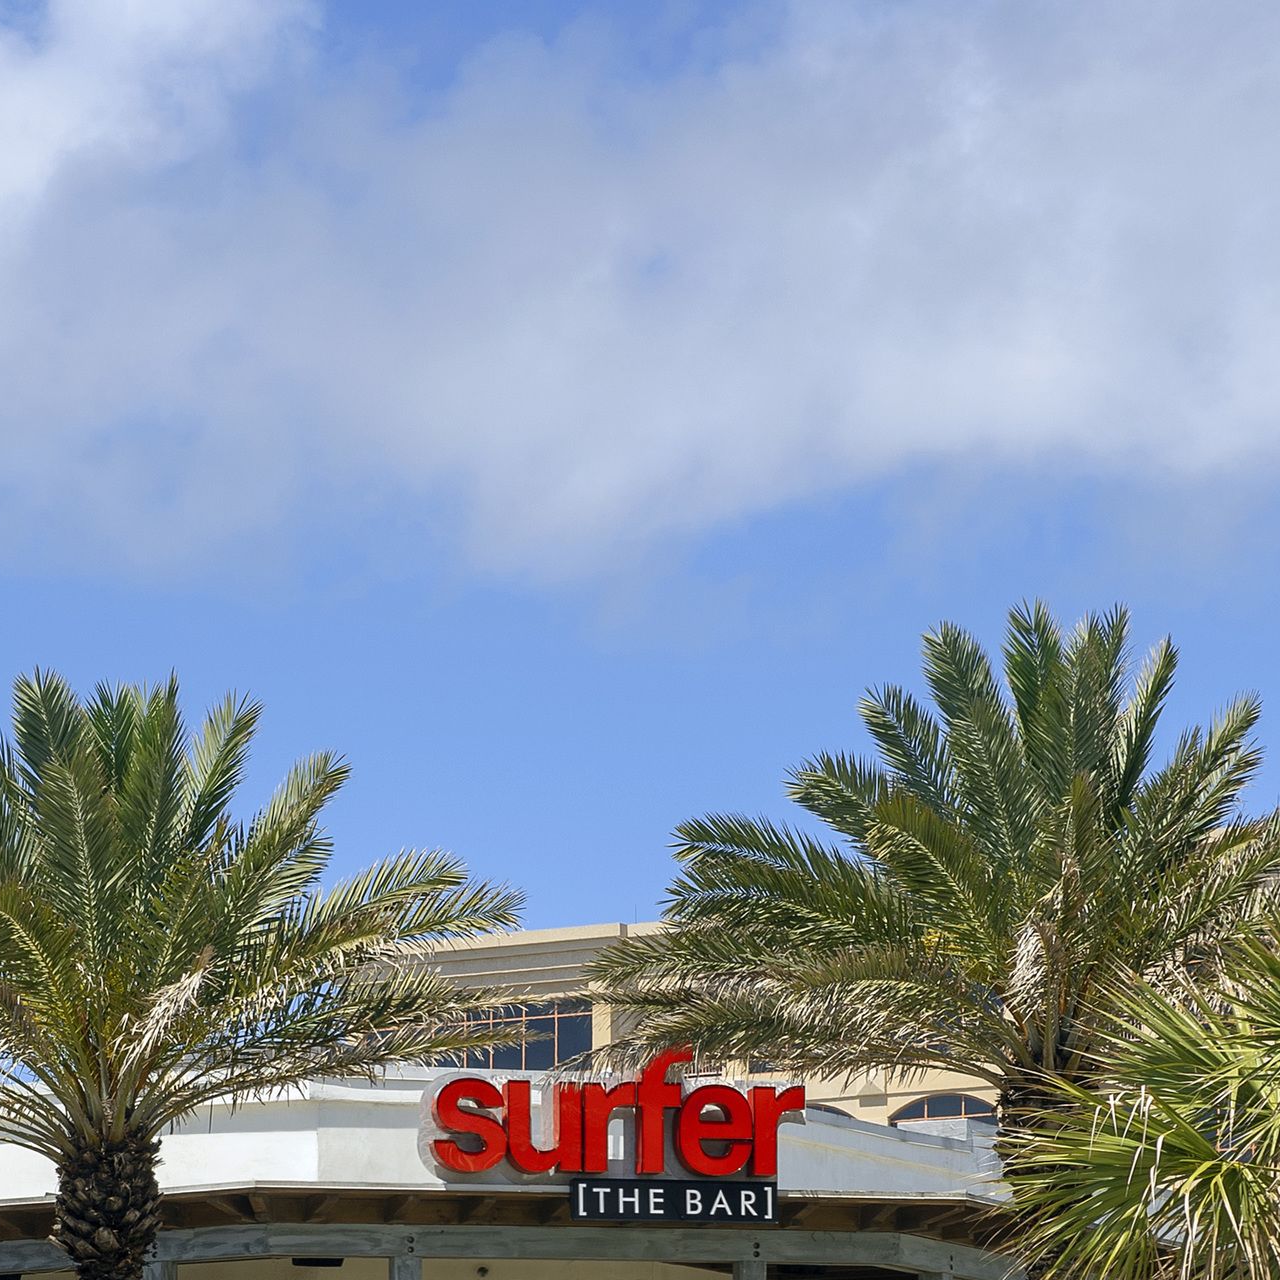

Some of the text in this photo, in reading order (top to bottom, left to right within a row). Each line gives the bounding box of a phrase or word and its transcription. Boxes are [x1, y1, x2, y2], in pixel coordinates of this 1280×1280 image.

[428, 1043, 806, 1177] surfer
[578, 1183, 773, 1219] [THE BAR]
